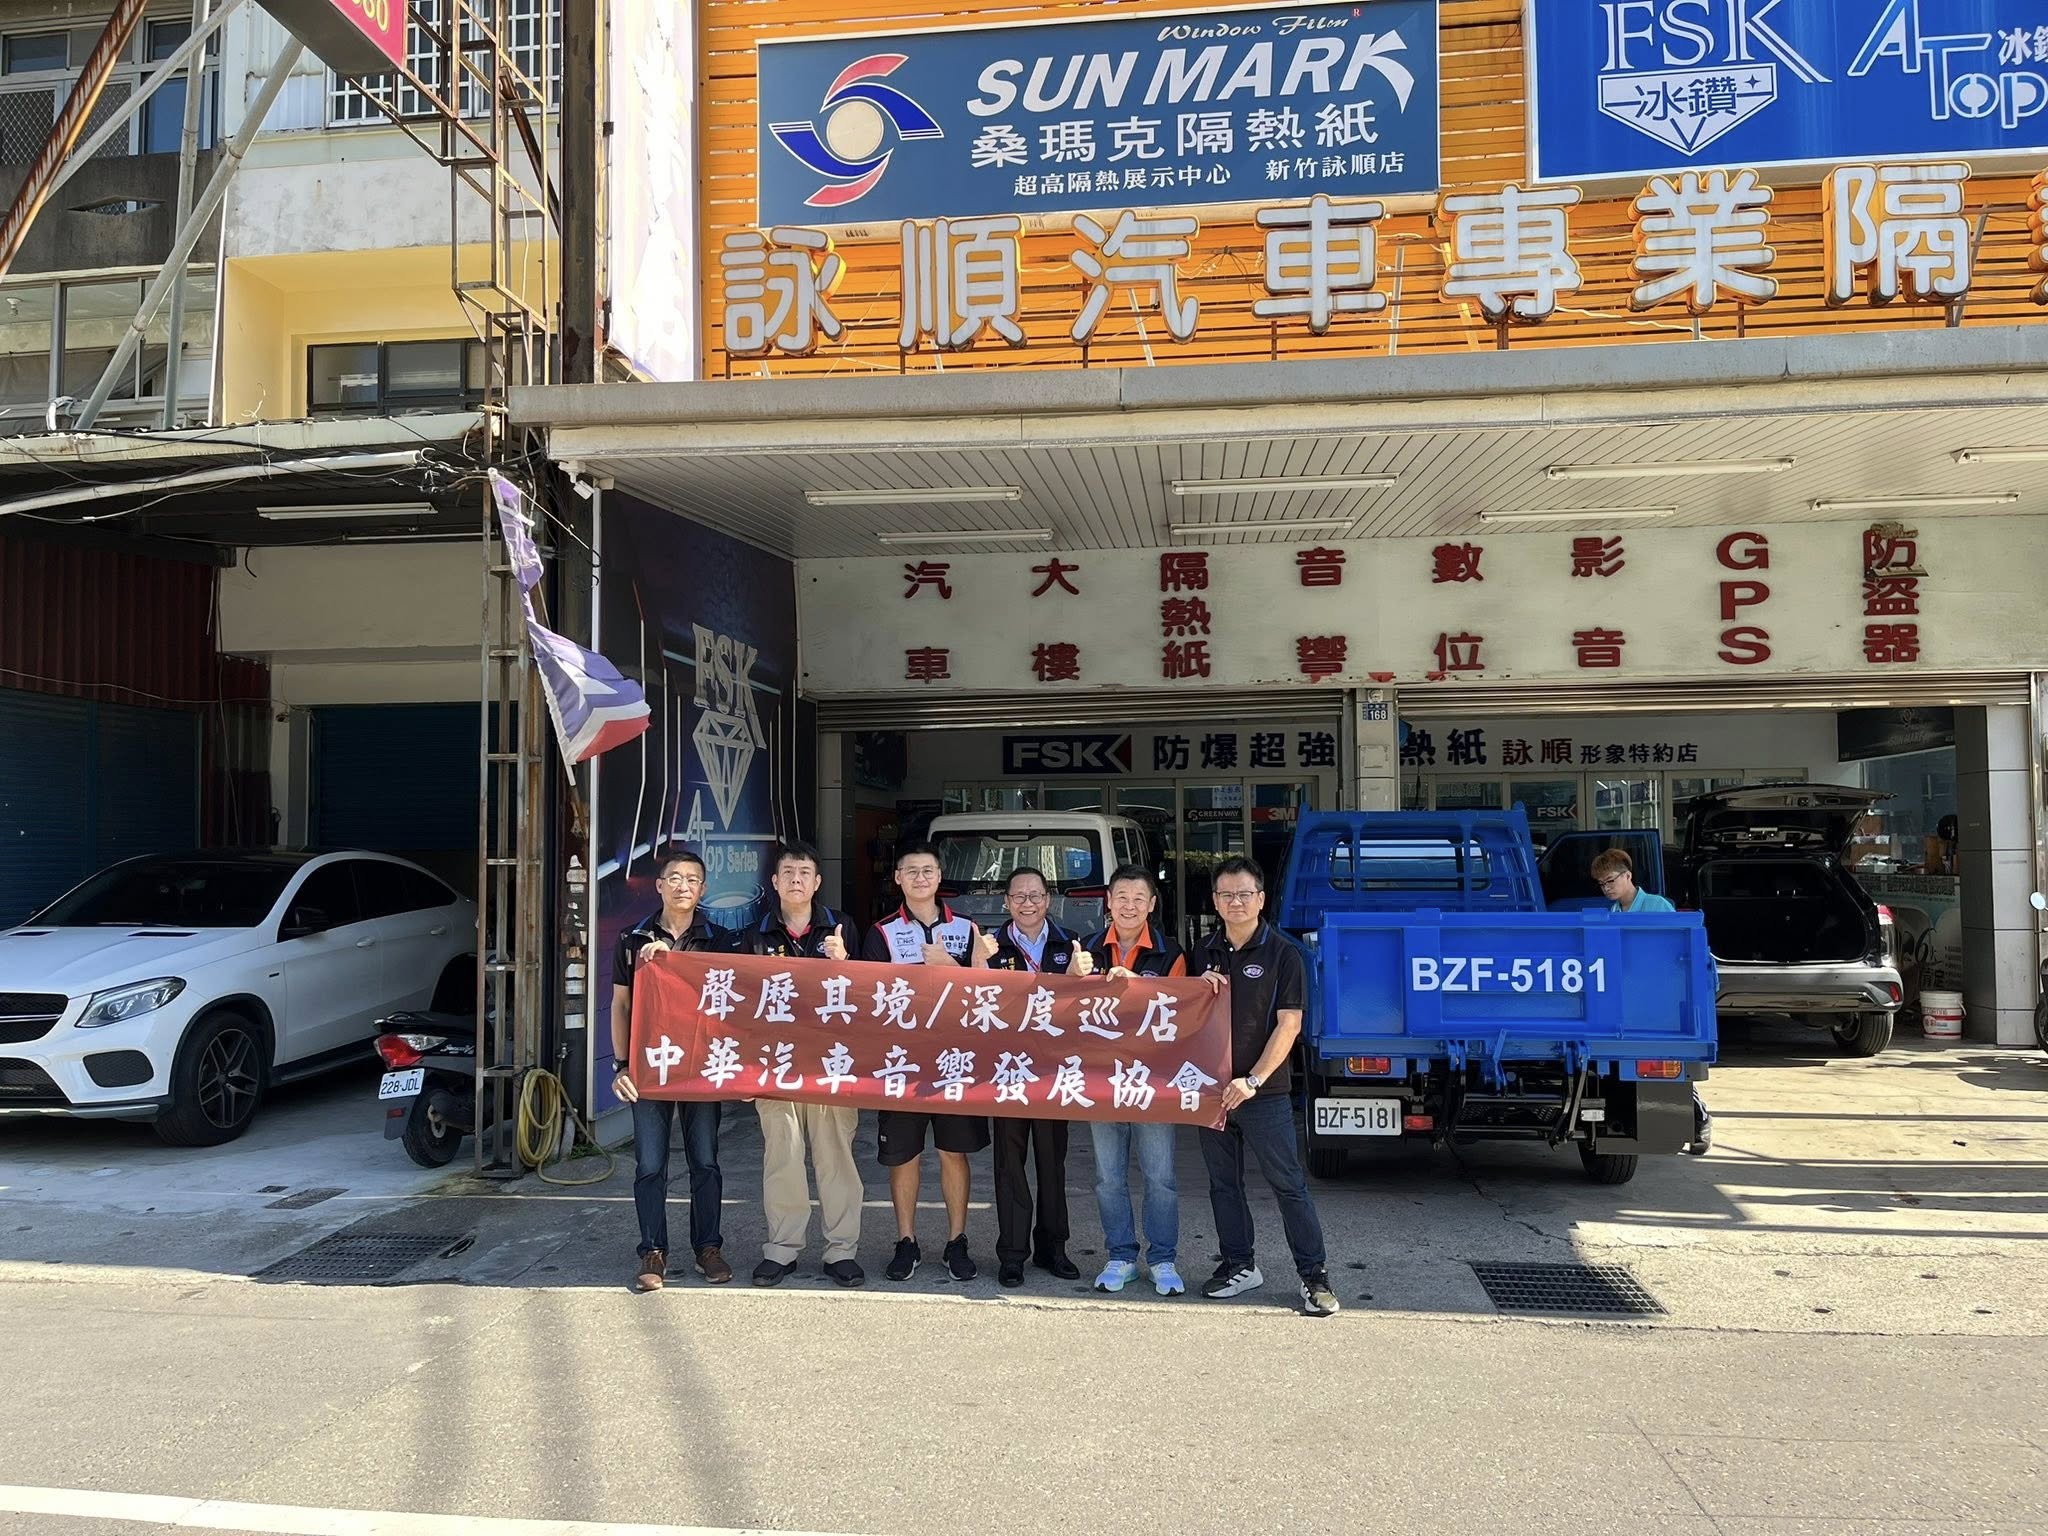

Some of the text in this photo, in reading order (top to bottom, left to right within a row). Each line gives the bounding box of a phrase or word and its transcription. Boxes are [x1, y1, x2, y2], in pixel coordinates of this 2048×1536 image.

[1157, 13, 1349, 42] Window Film
[1599, 0, 1833, 83] FSK
[967, 29, 1416, 118] SUN MARK
[1635, 75, 1737, 121] 冰鑽
[971, 100, 1379, 168] 桑瑪克隔熱紙
[1013, 151, 1406, 197] 超高隔熱展示中心 新竹詠順店
[720, 160, 2048, 356] 詠順汽車專業隔
[904, 560, 952, 684] 汽車
[1160, 551, 1211, 680] 隔熱紙
[1295, 547, 1347, 677] 音響
[1431, 542, 1485, 671] 數位
[1571, 536, 1626, 668] 影音
[1716, 531, 1771, 665] GPS
[1863, 527, 1920, 663] 防盜器
[692, 622, 767, 750] FSK
[1370, 710, 1387, 720] 168
[1012, 741, 1105, 768] FSK
[1153, 733, 1336, 770] 防爆超強
[1502, 738, 1573, 765] 詠順
[1580, 743, 1698, 764] 形象特約店
[1268, 808, 1296, 821] 3M
[1537, 807, 1568, 818] FSK
[726, 844, 759, 873] Series
[697, 966, 1178, 1043] 聲歷其境/深度巡店
[1412, 957, 1605, 993] BZF-5181
[644, 1036, 1219, 1113] 中華汽車音響發展協會
